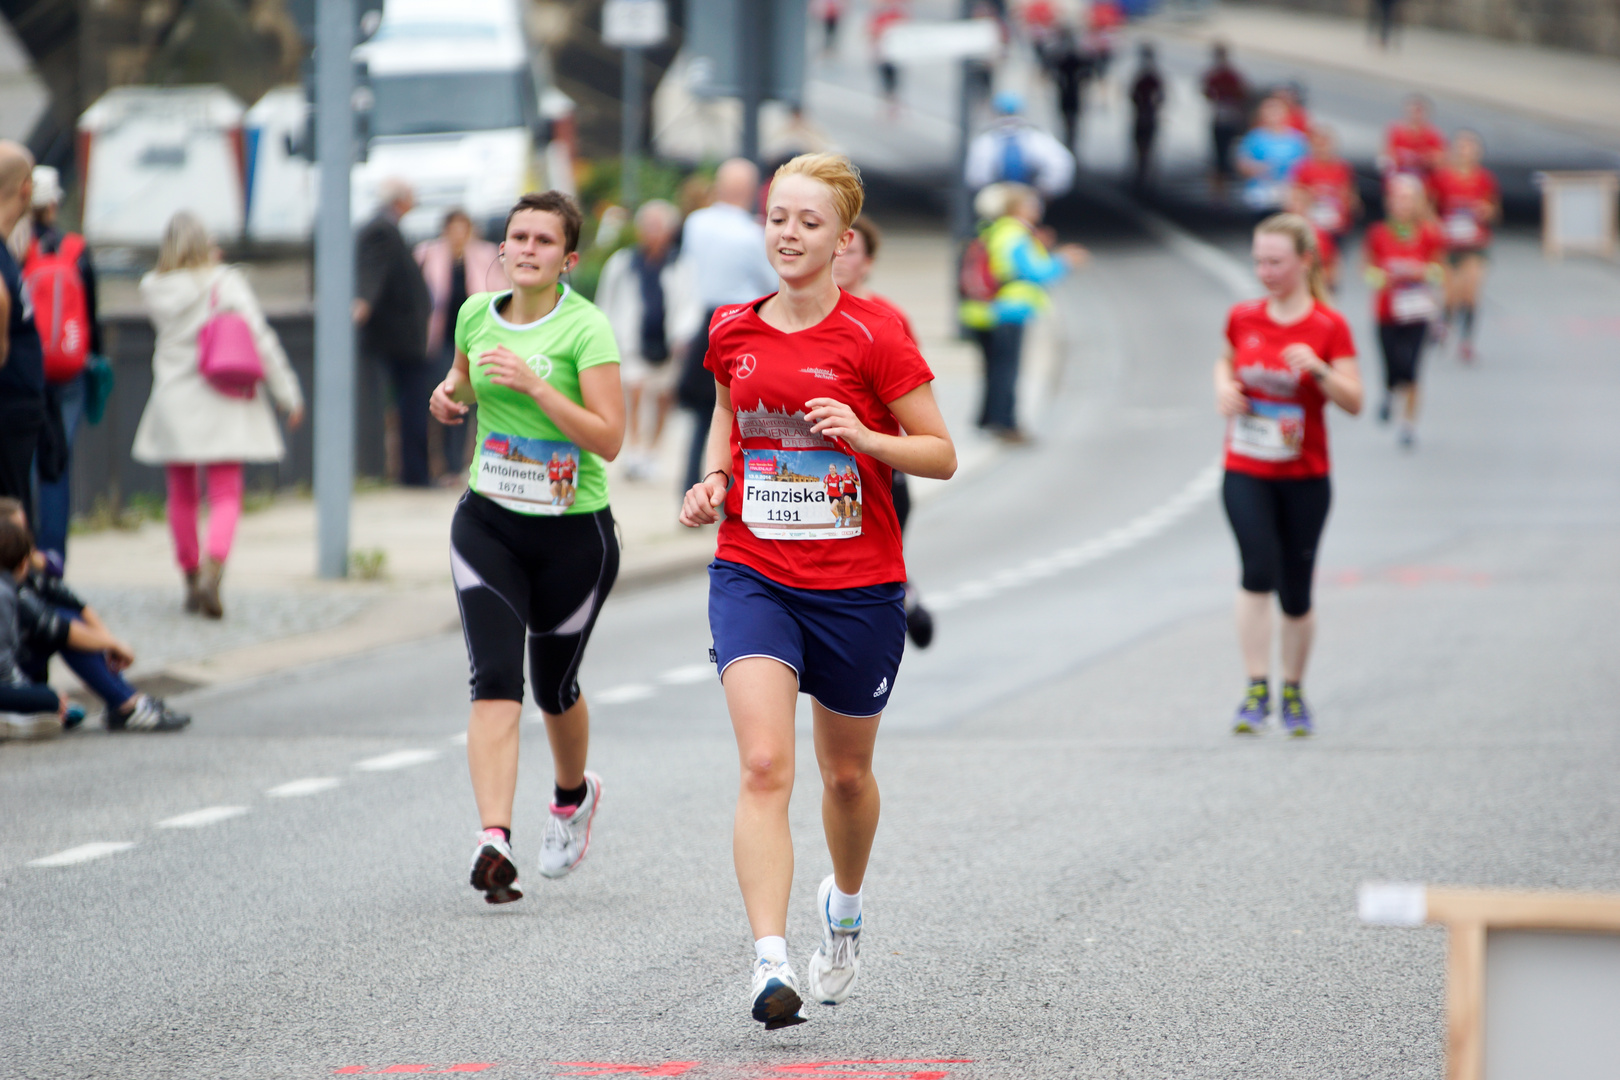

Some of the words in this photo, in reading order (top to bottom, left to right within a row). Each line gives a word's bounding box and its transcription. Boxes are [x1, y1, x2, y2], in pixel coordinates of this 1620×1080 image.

[483, 461, 545, 481] Antoinette
[498, 481, 525, 494] 1675
[747, 486, 825, 503] Franziska
[767, 509, 801, 521] 1191
